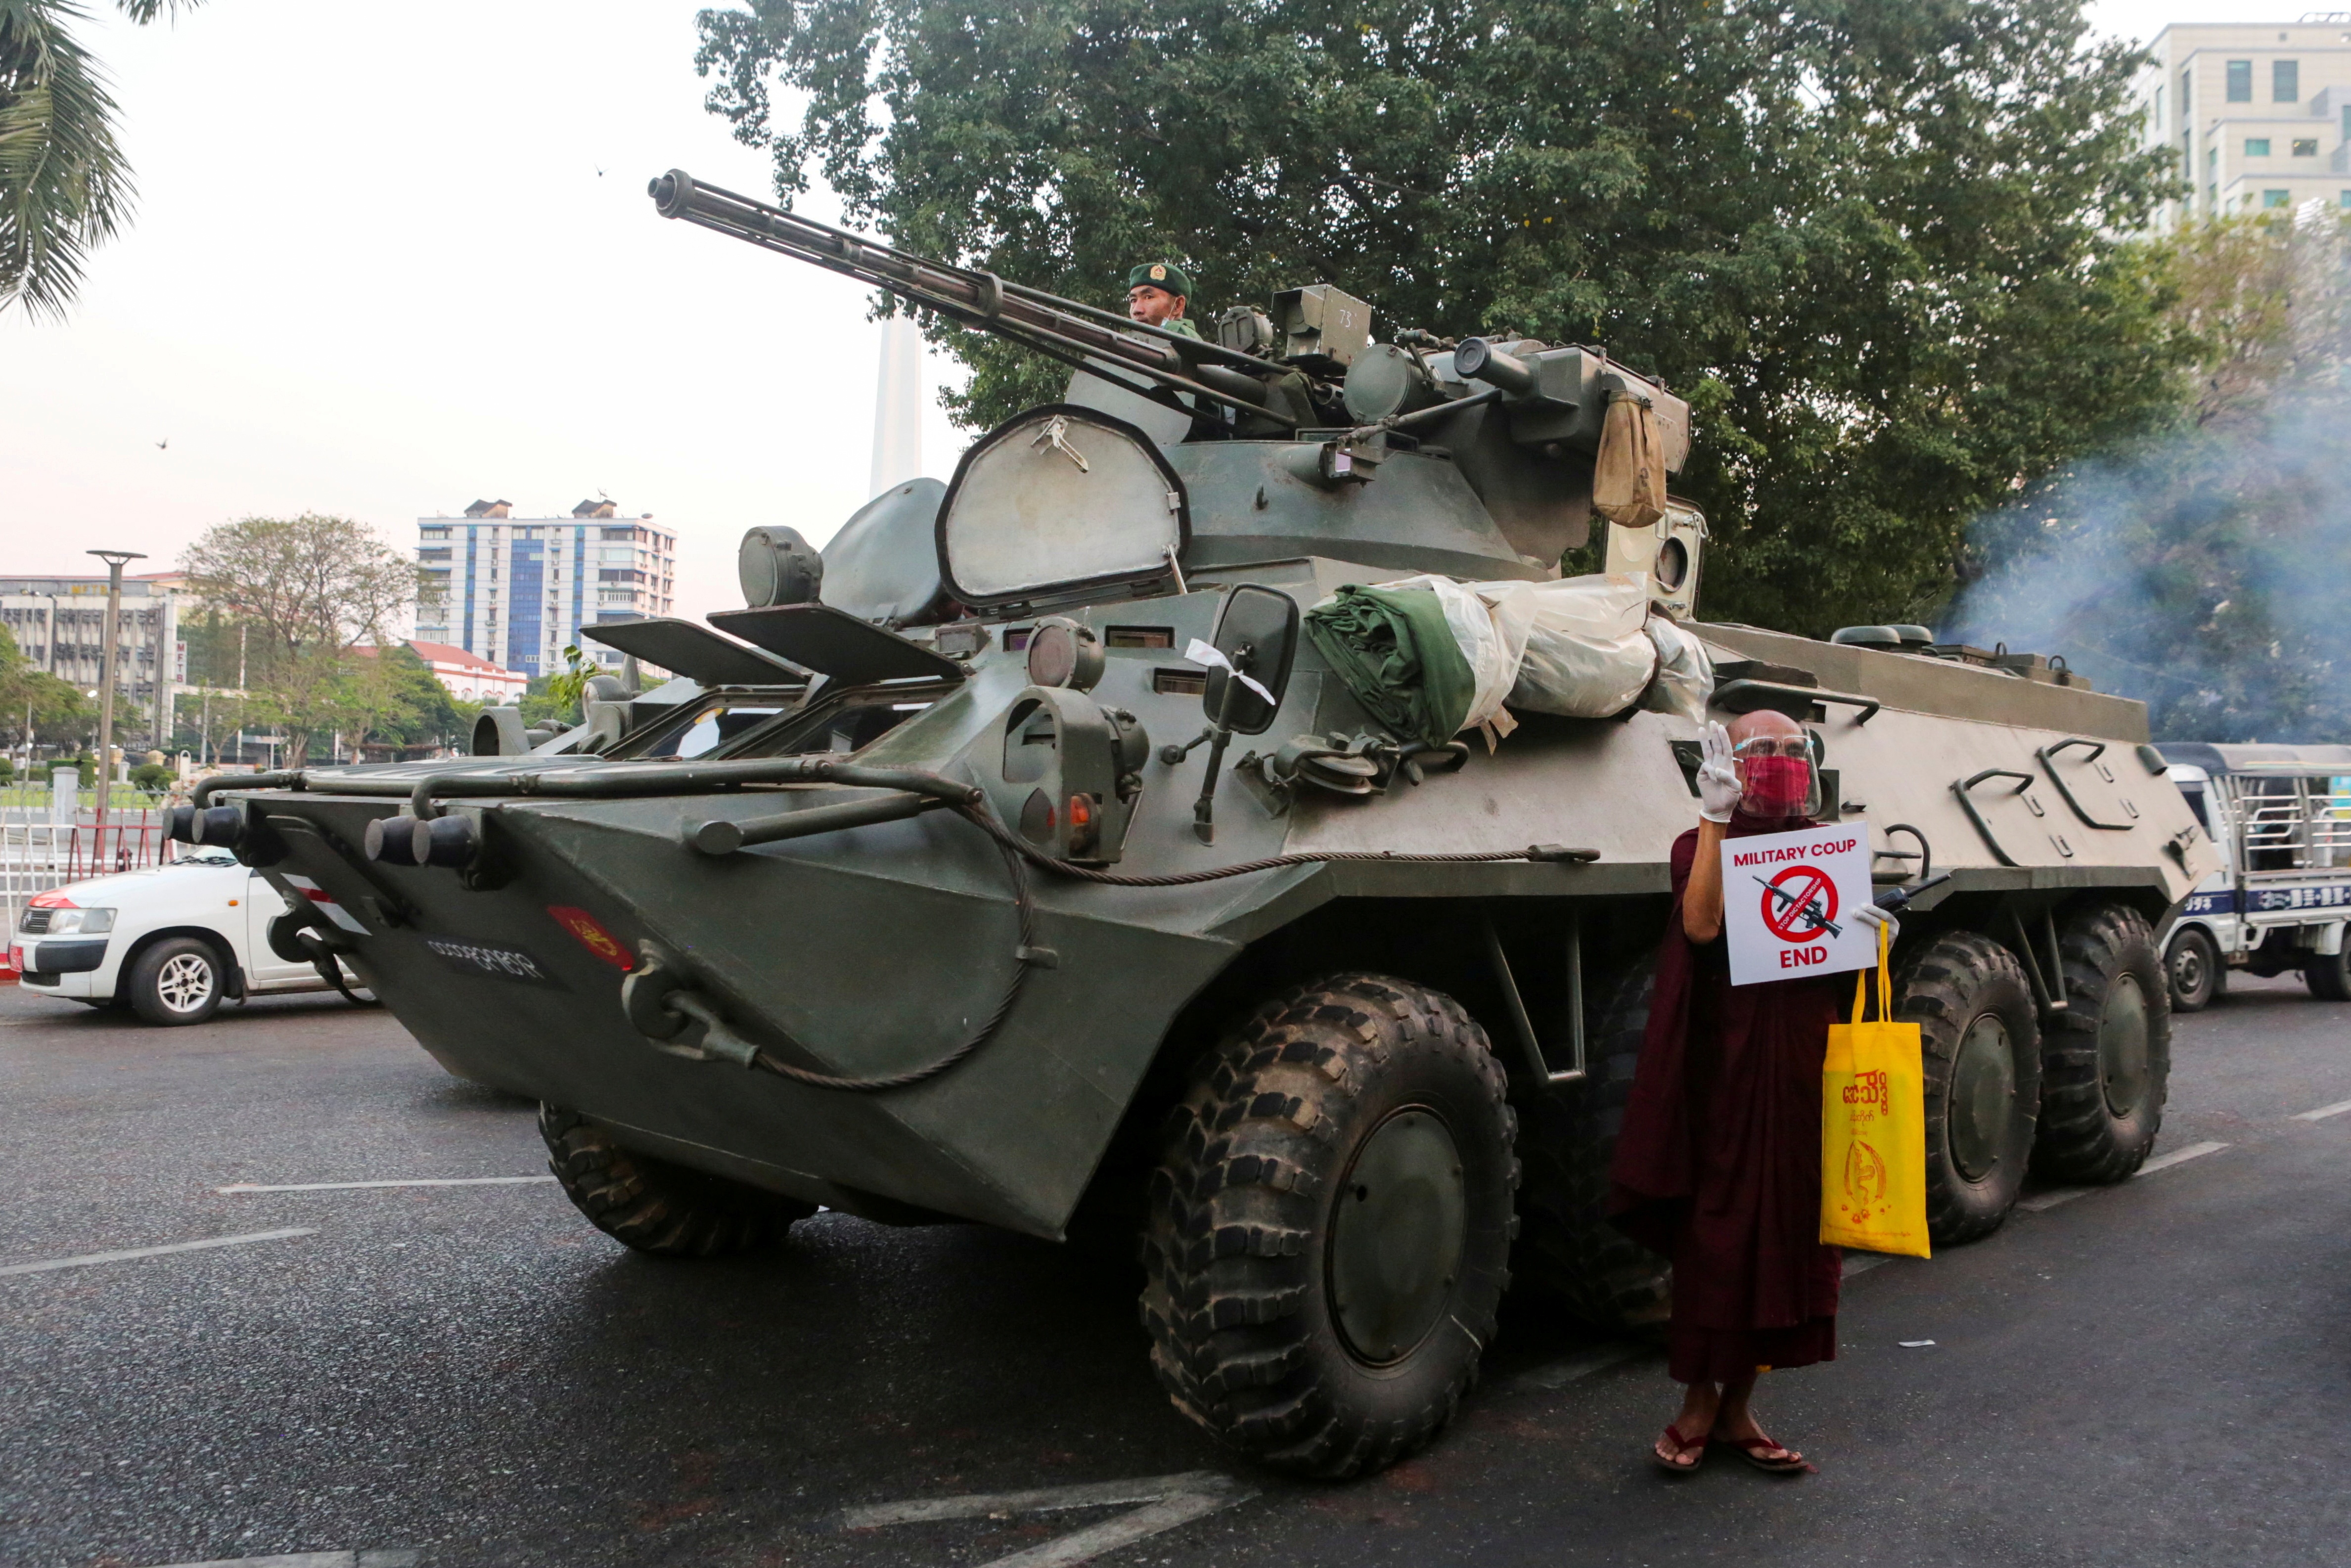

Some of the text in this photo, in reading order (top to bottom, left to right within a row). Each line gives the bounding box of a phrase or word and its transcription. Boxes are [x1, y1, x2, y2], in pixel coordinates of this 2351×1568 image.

[1734, 839, 1857, 867] MILITARY COUP
[1778, 878, 1821, 930] STOP DICTACTORSHIP
[1779, 946, 1828, 968] END
